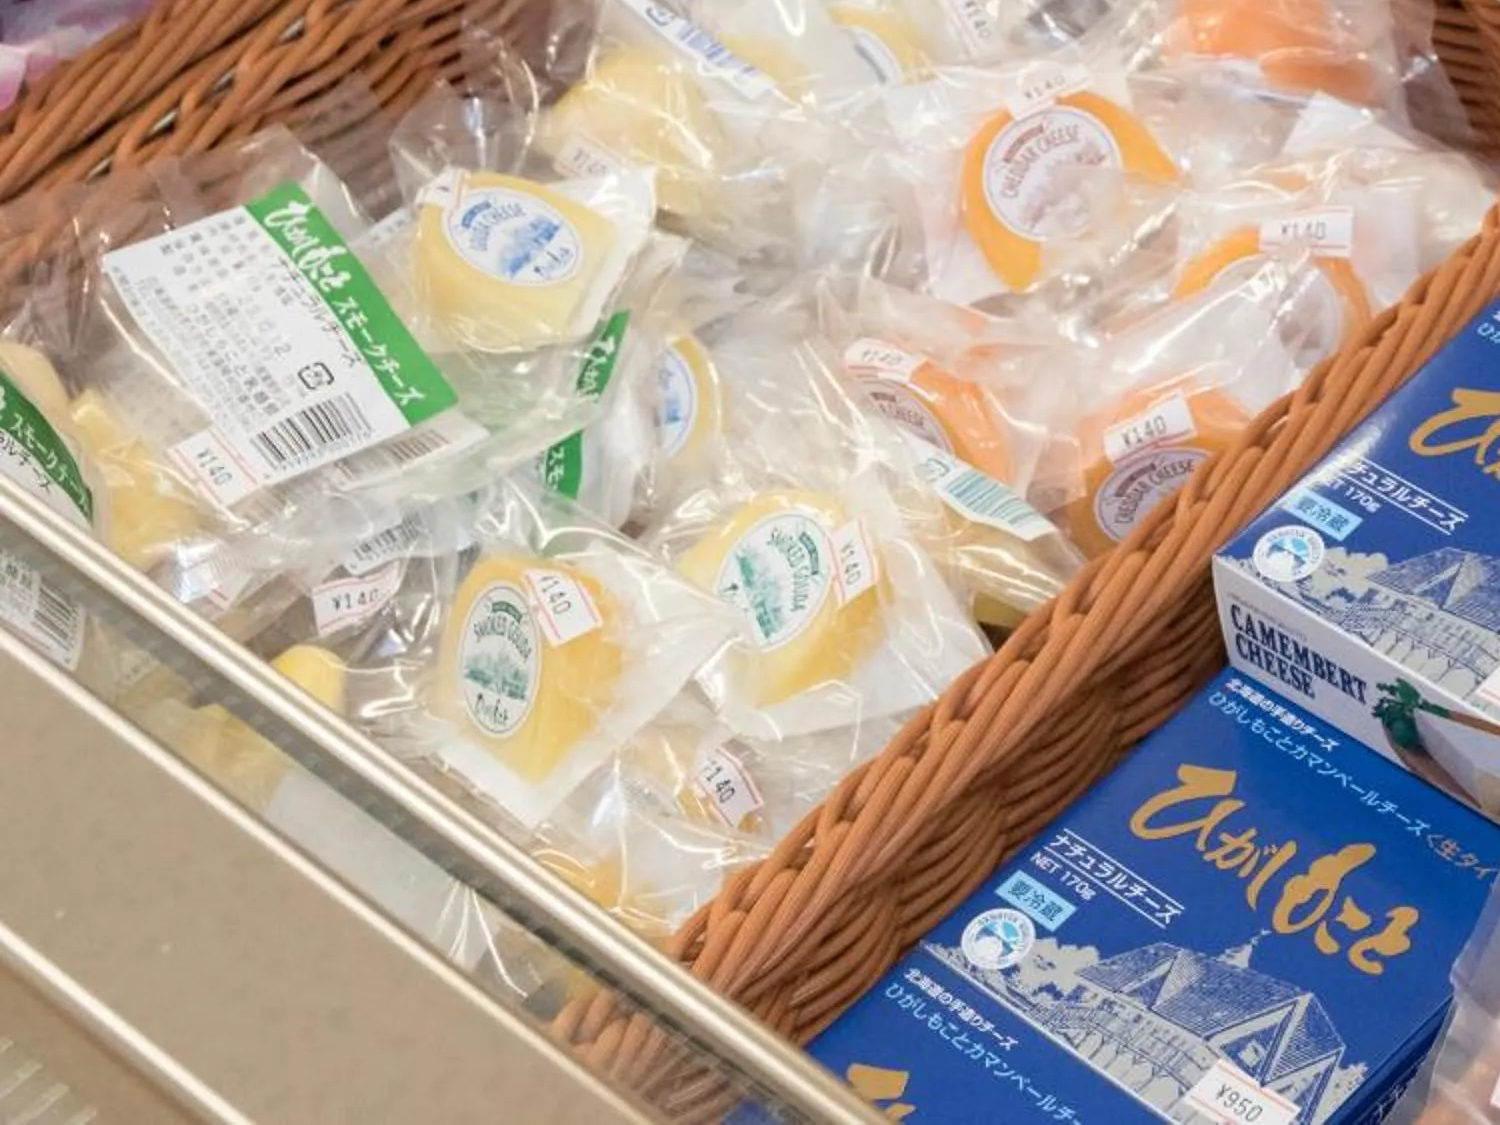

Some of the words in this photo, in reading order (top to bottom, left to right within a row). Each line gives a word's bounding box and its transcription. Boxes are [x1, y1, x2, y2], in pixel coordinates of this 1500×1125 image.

[332, 297, 426, 405] スモークチーズ
[1121, 415, 1166, 448] ¥140
[1230, 603, 1368, 706] CAMEMBERT
[1235, 634, 1316, 700] CHEESE
[1005, 877, 1064, 925] 要冷蔵
[1029, 851, 1061, 877] NET
[1060, 871, 1097, 902] 170g
[1047, 830, 1184, 929] ナチュラルチーズ
[1216, 1079, 1263, 1121] ¥950
